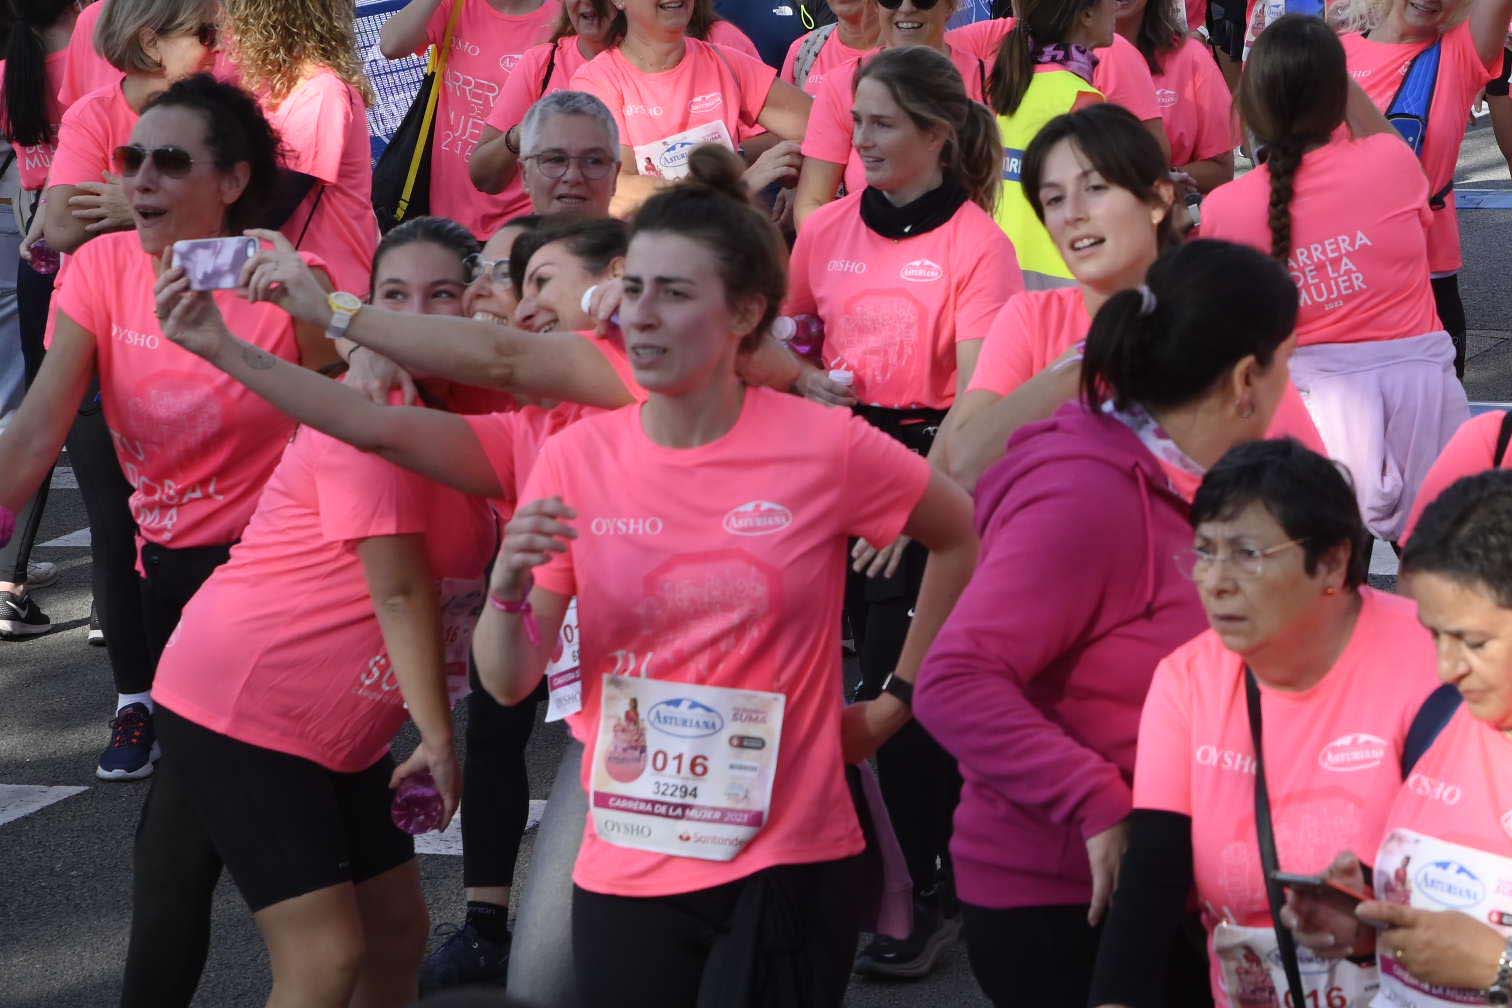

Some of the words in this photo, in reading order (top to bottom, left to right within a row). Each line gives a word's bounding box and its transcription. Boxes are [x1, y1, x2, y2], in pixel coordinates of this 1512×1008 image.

[1327, 255, 1357, 279] LA
[1299, 272, 1368, 308] MUJER
[592, 517, 663, 536] OYSHO
[653, 709, 717, 731] ASTURIANA
[651, 749, 710, 777] 016
[653, 780, 699, 800] 32294
[608, 796, 652, 814] CARRERA
[654, 804, 669, 817] DE
[670, 805, 683, 817] LA
[685, 806, 722, 821] MUJER
[604, 818, 652, 839] OYSHO
